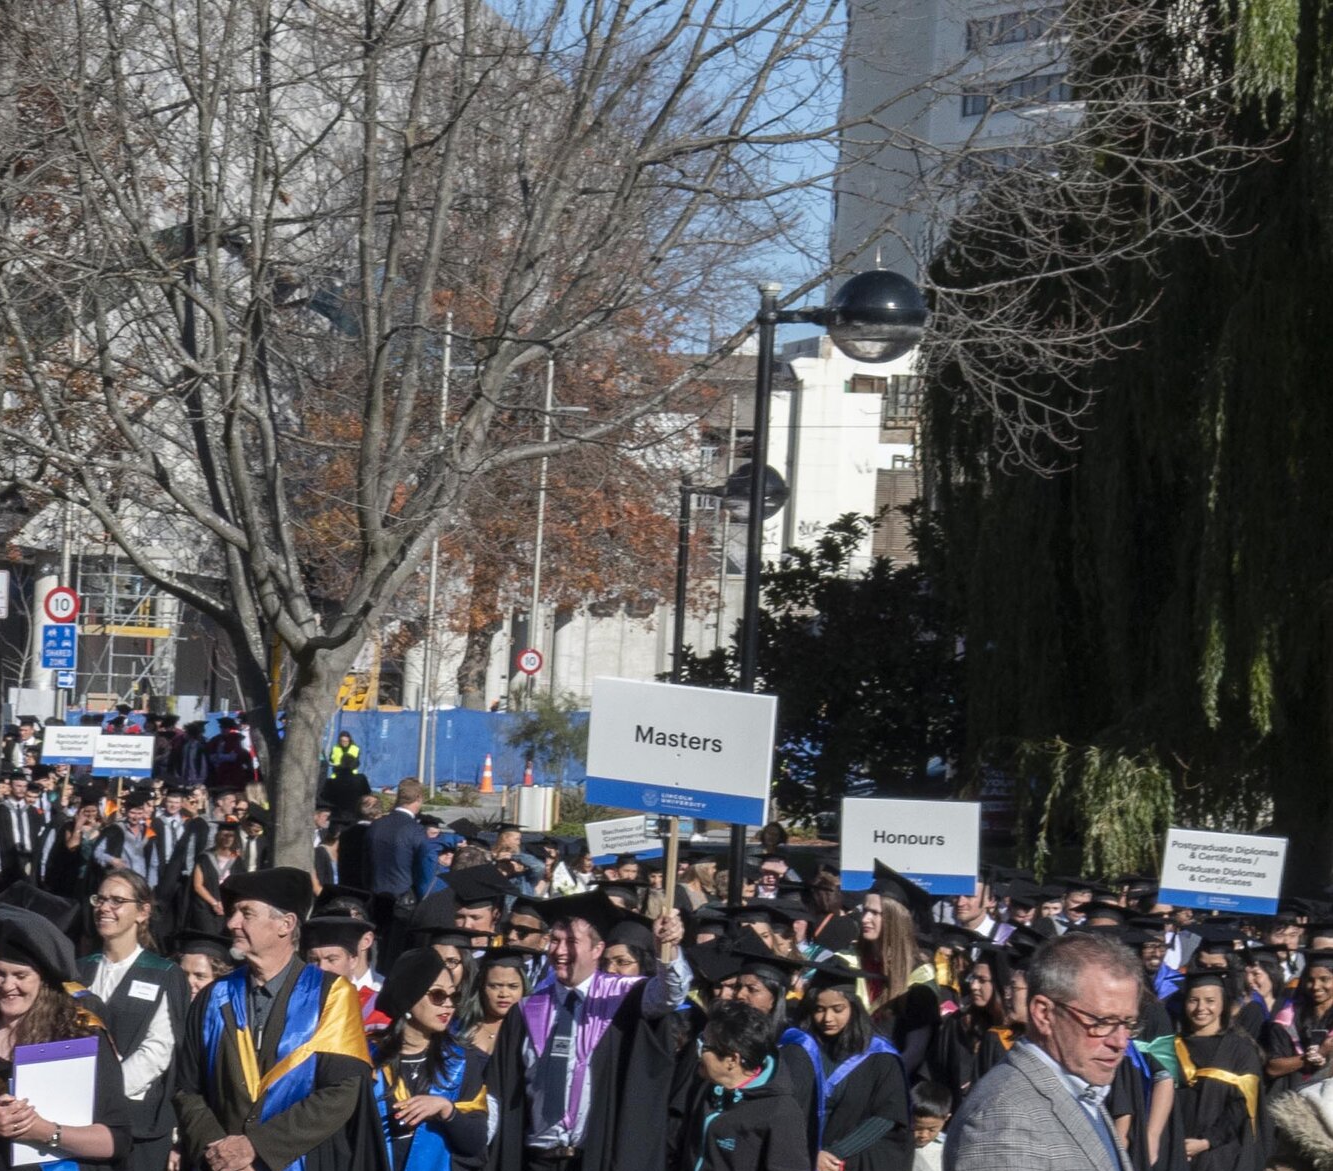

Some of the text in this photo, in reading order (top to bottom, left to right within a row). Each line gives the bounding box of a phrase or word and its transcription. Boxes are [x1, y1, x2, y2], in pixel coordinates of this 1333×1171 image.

[54, 598, 70, 612] 10
[45, 649, 72, 657] SHARED
[49, 658, 67, 666] ZONE
[525, 656, 537, 666] 10
[634, 724, 723, 753] Masters
[660, 792, 694, 802] LINCOLN
[660, 798, 708, 809] UNIVERSITY
[873, 829, 946, 846] Honours
[1171, 840, 1280, 857] Postgraduate Diplomas
[1189, 851, 1196, 859] &
[1198, 852, 1252, 864] Certificates
[1177, 863, 1267, 879] Graduate Diplomas
[1188, 874, 1253, 887] & Certificates
